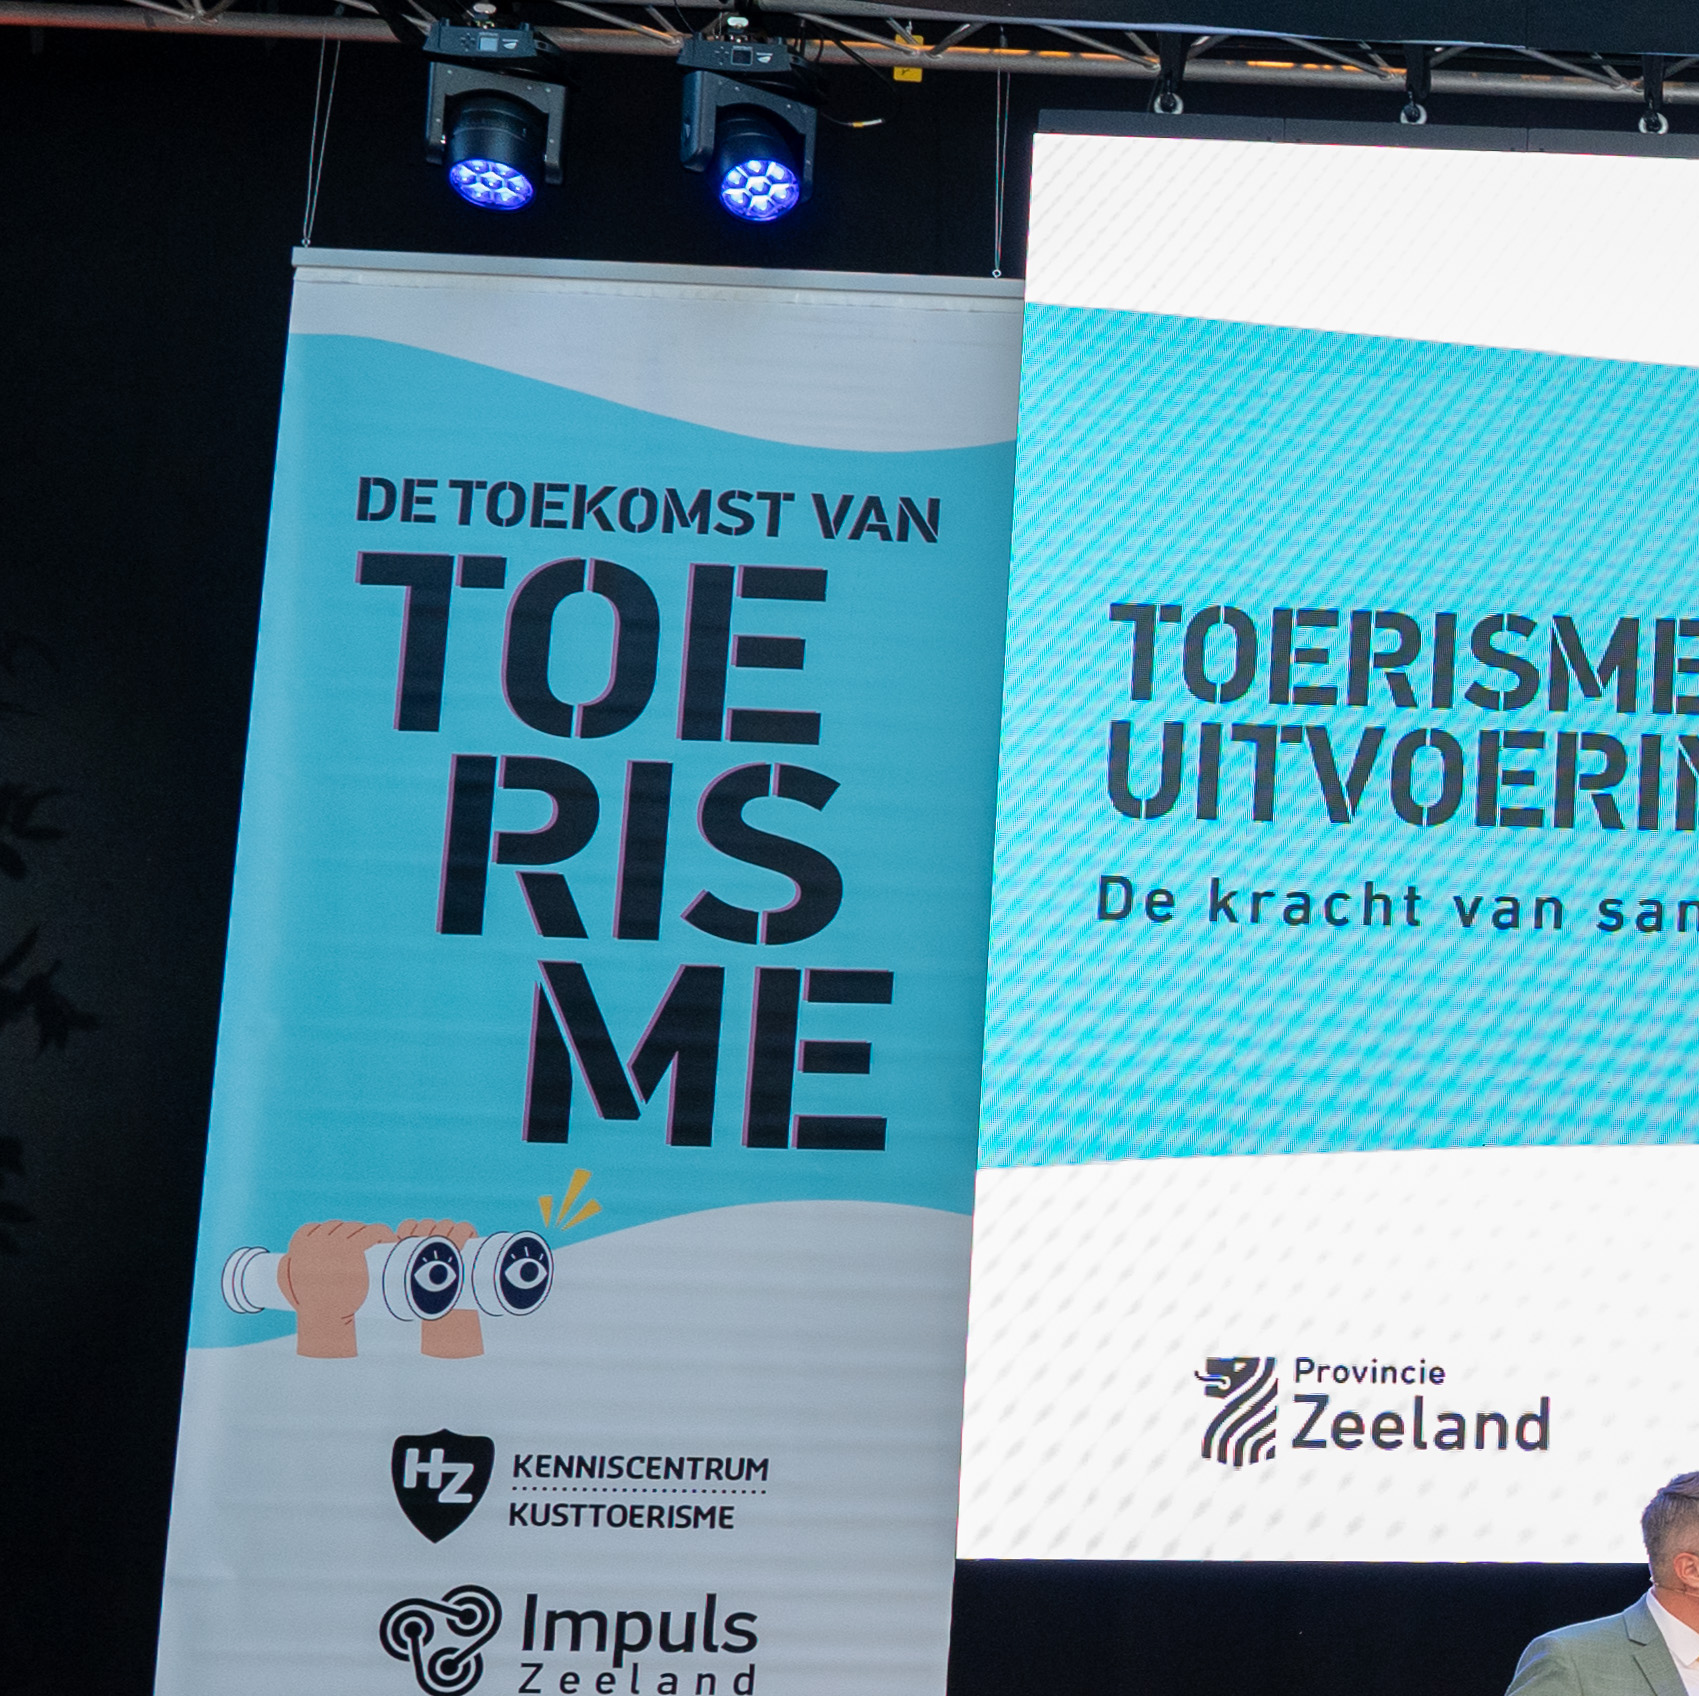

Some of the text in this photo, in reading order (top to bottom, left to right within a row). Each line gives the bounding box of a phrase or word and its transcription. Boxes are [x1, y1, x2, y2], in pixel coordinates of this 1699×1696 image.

[355, 476, 941, 543] DE TOEKOMST VAN
[355, 550, 829, 745] TOE
[435, 753, 844, 946] RIS
[1096, 874, 1175, 923] De
[1209, 877, 1422, 928] kracht
[1453, 892, 1564, 931] van
[521, 960, 895, 1152] ME
[1294, 1358, 1446, 1386] Provincie
[1291, 1392, 1551, 1452] Zeeland
[512, 1454, 770, 1483] KENNISCENTRUM
[508, 1502, 735, 1530] KUSTTOERISME
[521, 1592, 759, 1668] Impuls
[518, 1663, 756, 1696] Zeeland
